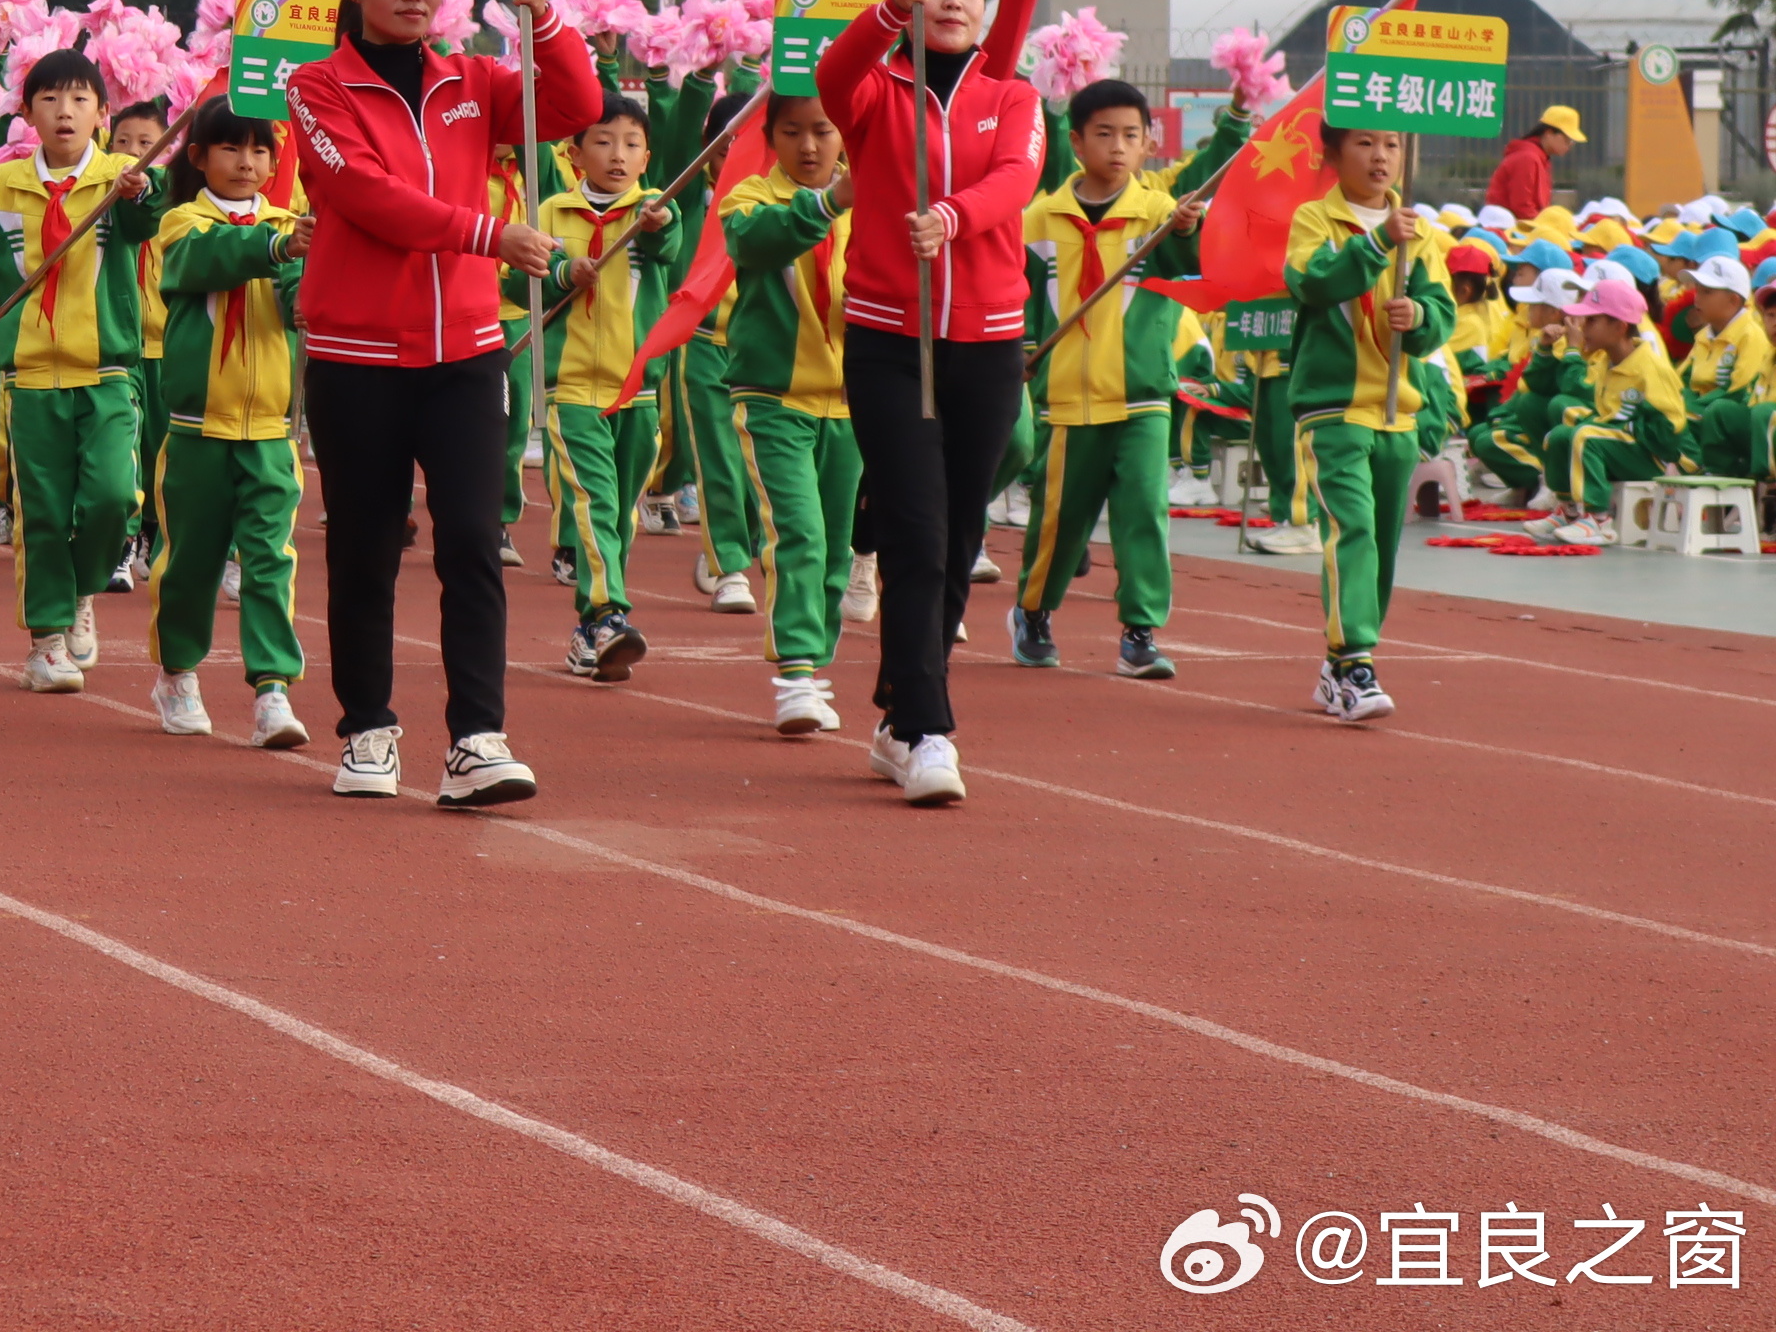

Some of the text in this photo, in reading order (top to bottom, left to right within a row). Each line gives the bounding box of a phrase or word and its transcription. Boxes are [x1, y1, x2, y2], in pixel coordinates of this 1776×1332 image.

[1379, 22, 1494, 43] 宜良县匡山小学
[1332, 71, 1497, 118] 三年级(4)班
